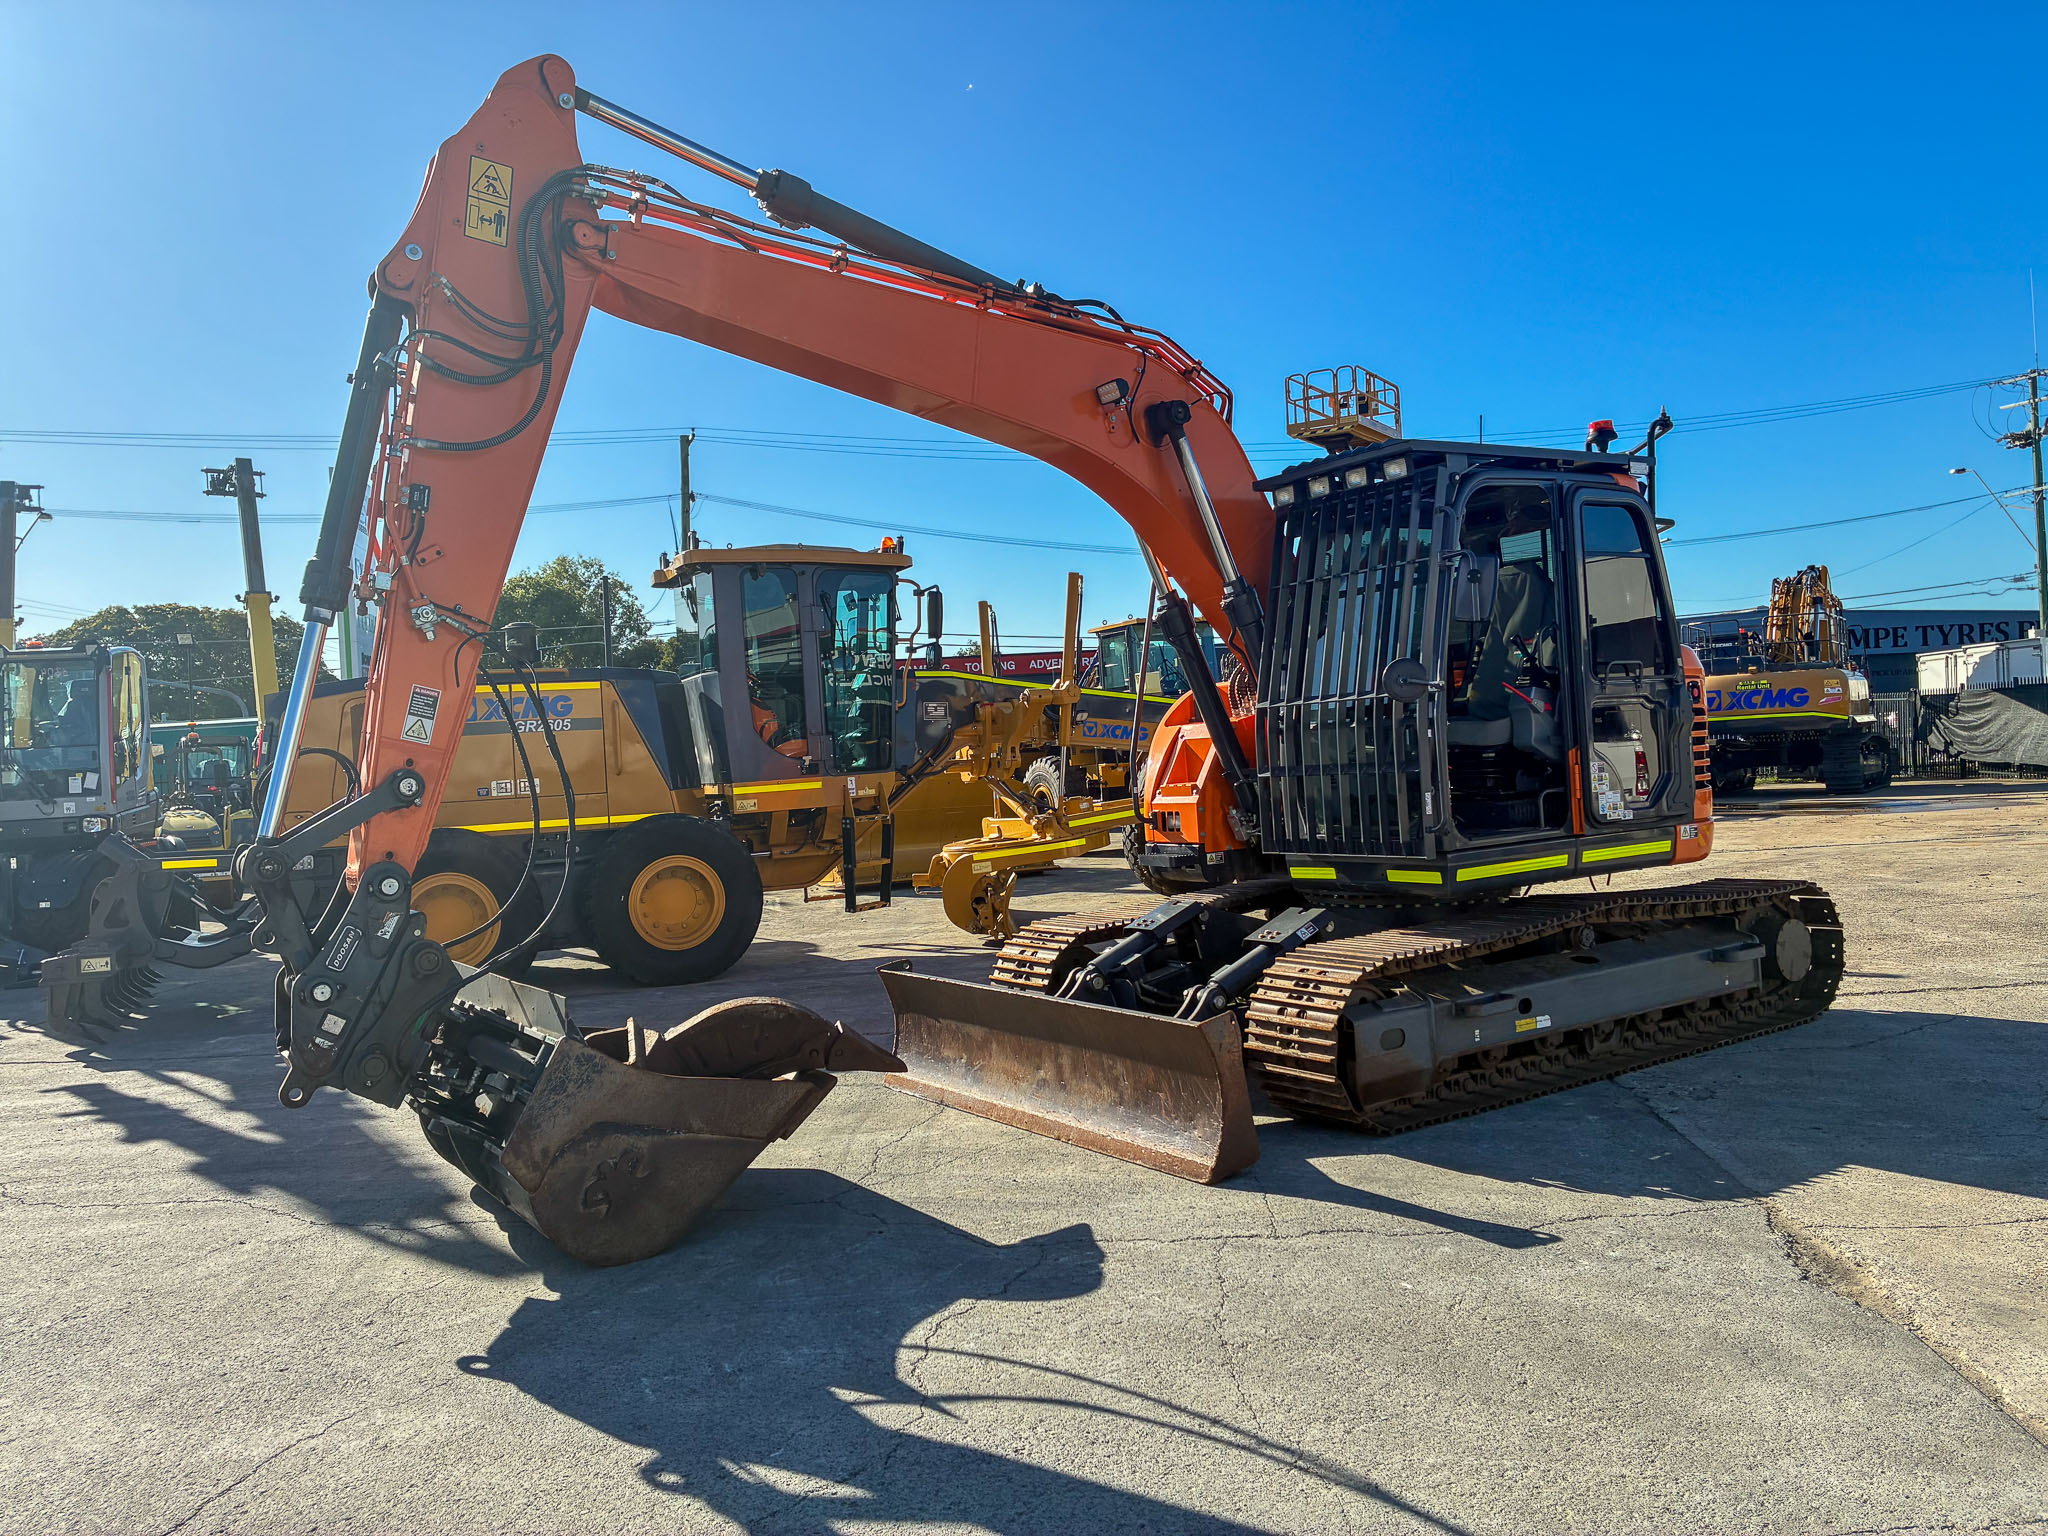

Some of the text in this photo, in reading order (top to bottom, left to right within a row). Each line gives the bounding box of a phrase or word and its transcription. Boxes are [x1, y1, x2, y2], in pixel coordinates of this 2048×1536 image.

[1915, 621, 2009, 646] TYRES
[2016, 620, 2041, 640] P
[964, 660, 1016, 672] TONG
[1725, 687, 1810, 711] XCMG
[1100, 723, 1149, 741] XCMG
[333, 930, 355, 967] DOOSAN
